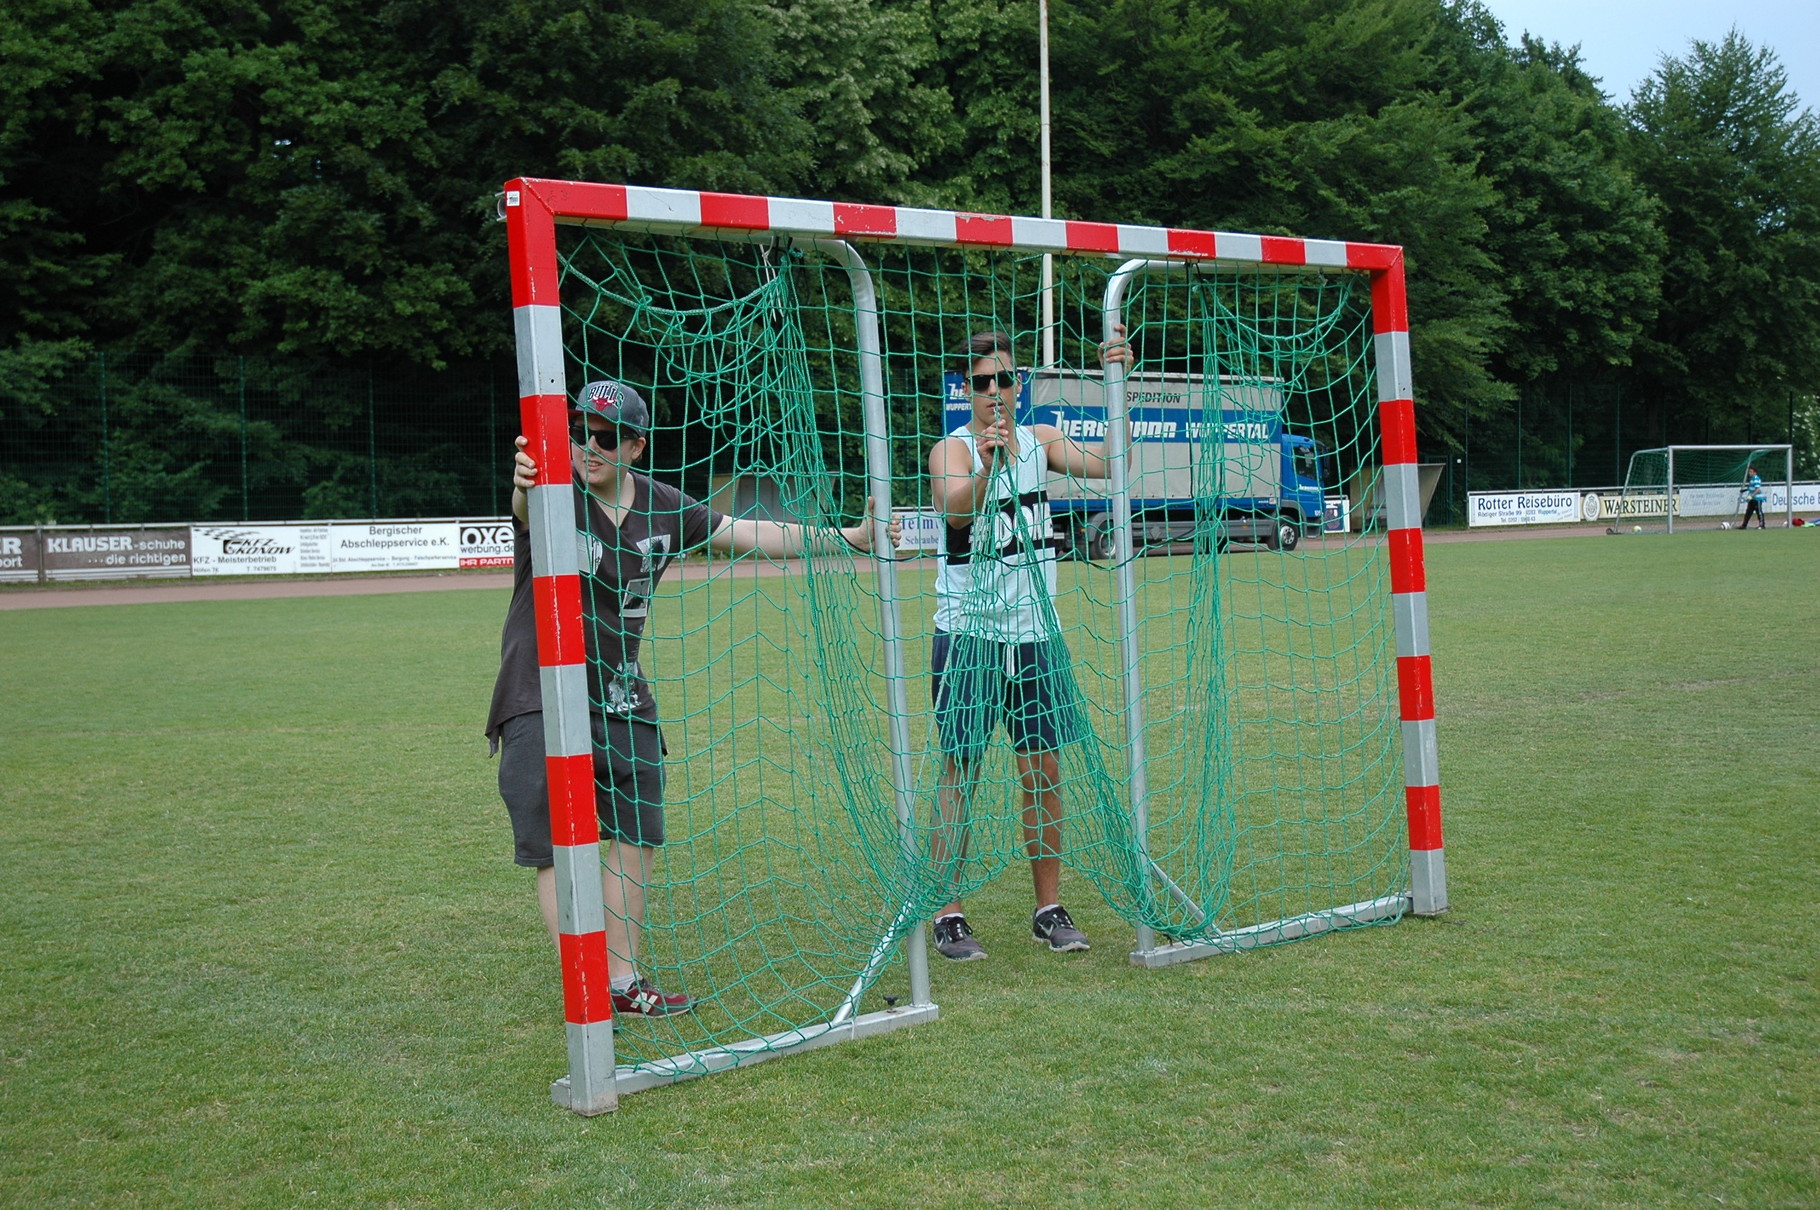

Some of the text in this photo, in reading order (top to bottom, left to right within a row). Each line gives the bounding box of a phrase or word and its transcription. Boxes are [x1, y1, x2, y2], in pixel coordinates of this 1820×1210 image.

[1126, 391, 1181, 404] SPEDITION
[1478, 495, 1573, 511] Rotter Reisebüro
[1772, 493, 1815, 506] Deusche
[1603, 499, 1678, 515] WARSTEINER
[369, 525, 423, 537] Bergischer
[0, 537, 22, 554] R
[340, 537, 450, 549] Abschleppservice e.K.
[130, 552, 187, 566] richtigen
[218, 556, 277, 564] Meisterbetrieb
[460, 558, 478, 566] IHR
